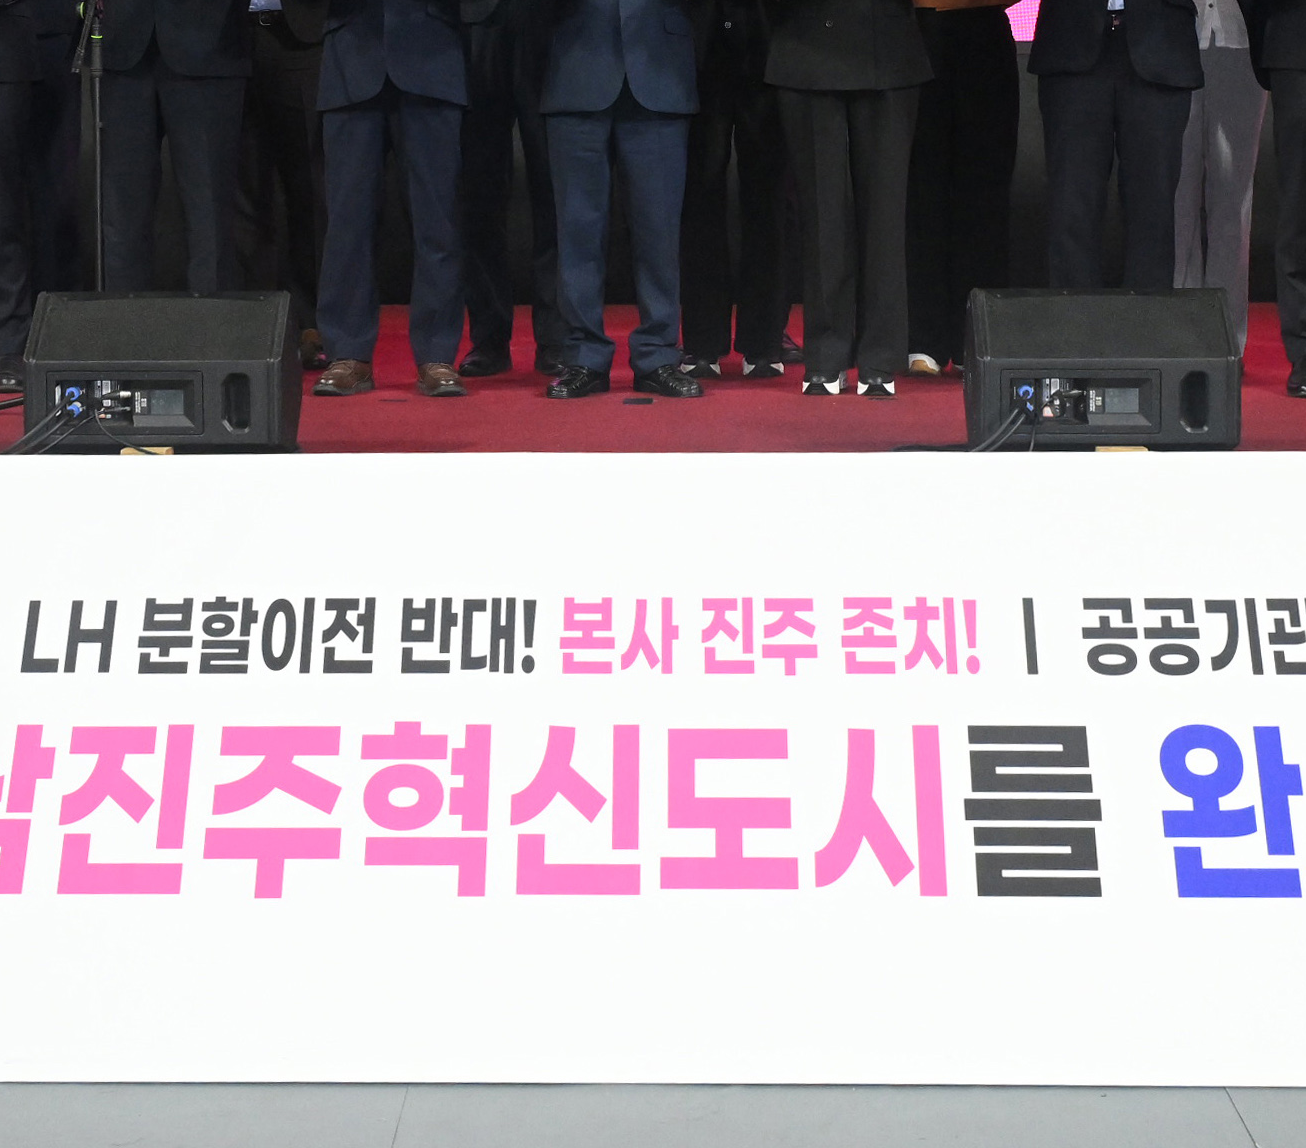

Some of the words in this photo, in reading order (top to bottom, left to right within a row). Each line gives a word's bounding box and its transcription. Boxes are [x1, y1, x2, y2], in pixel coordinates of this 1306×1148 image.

[21, 599, 118, 674] LH
[137, 595, 377, 675] 분할이전
[400, 596, 537, 674] 반대!
[559, 597, 679, 675] 본사
[701, 597, 818, 676] 진주
[841, 596, 981, 675] 존치!
